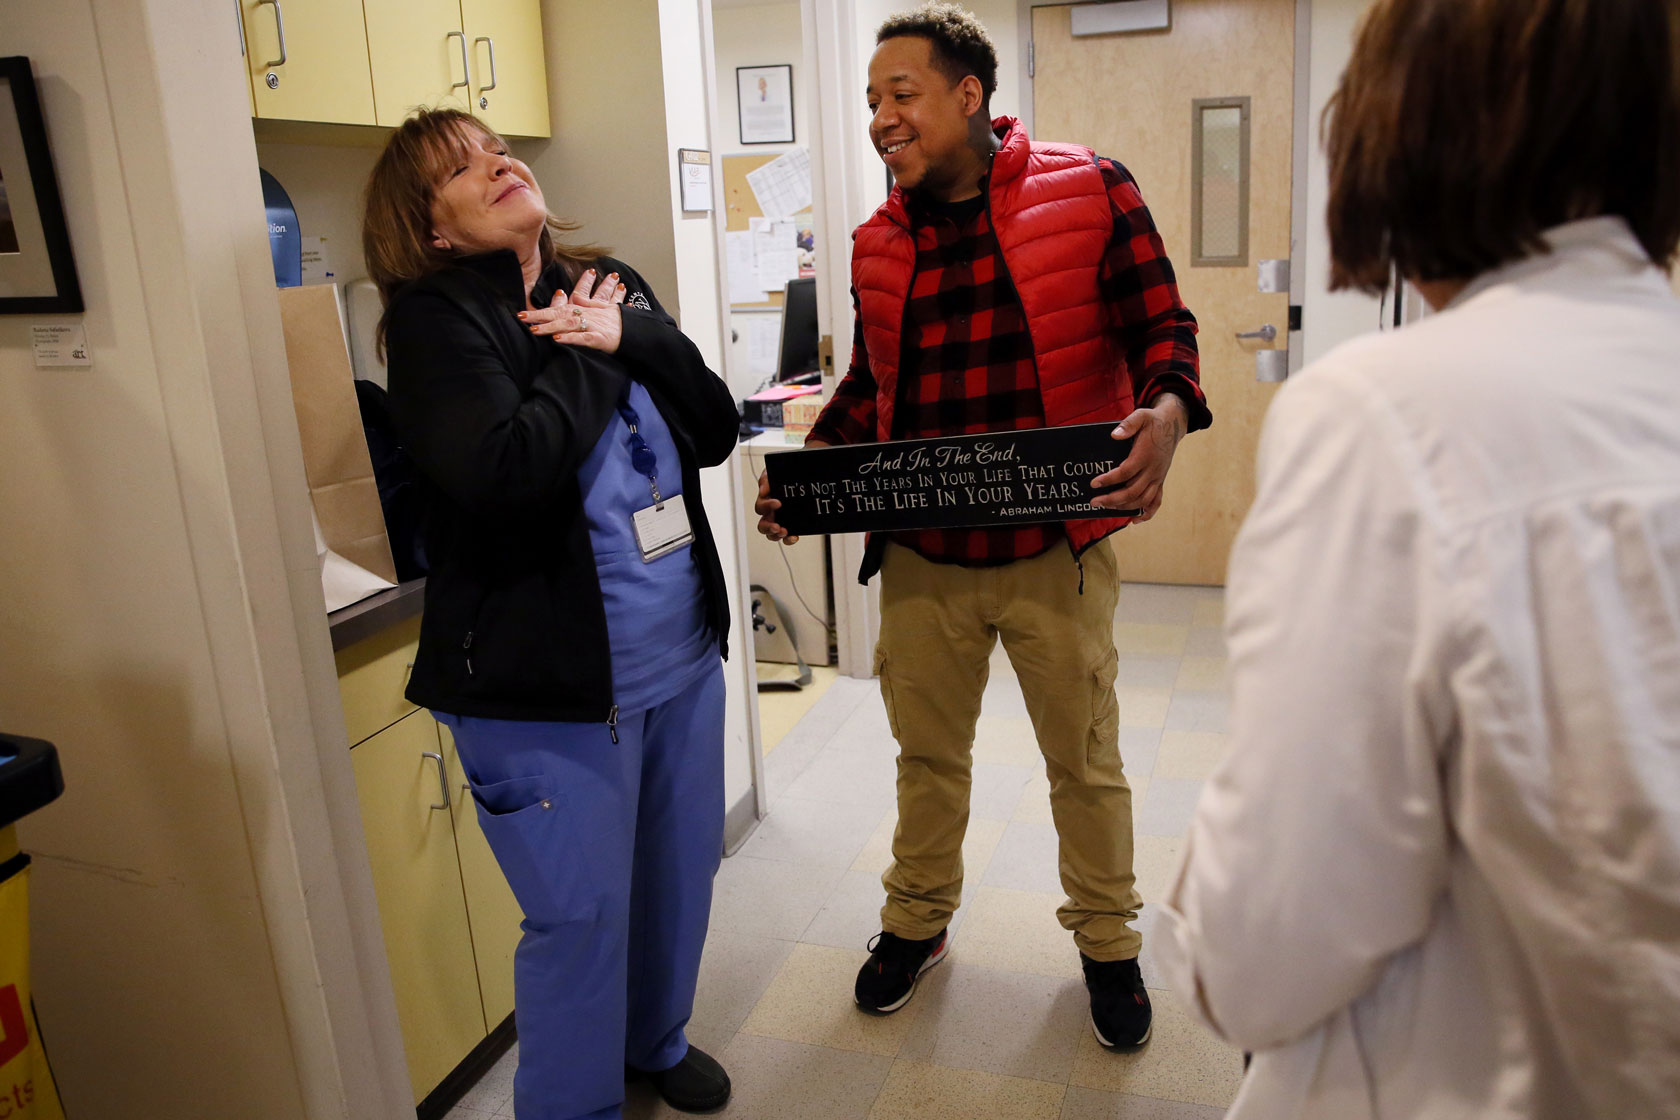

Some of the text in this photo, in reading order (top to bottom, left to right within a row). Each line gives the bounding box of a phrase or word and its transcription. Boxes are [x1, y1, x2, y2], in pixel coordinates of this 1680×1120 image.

[859, 441, 1021, 475] And In The End,
[783, 460, 1114, 498] IT'S NOT THE YEARS IN YOUR LIFE THAT COUNT
[815, 480, 1085, 515] IT'S THE LIFE IN YOUR YEARS.
[999, 505, 1053, 517] ABRAHAM
